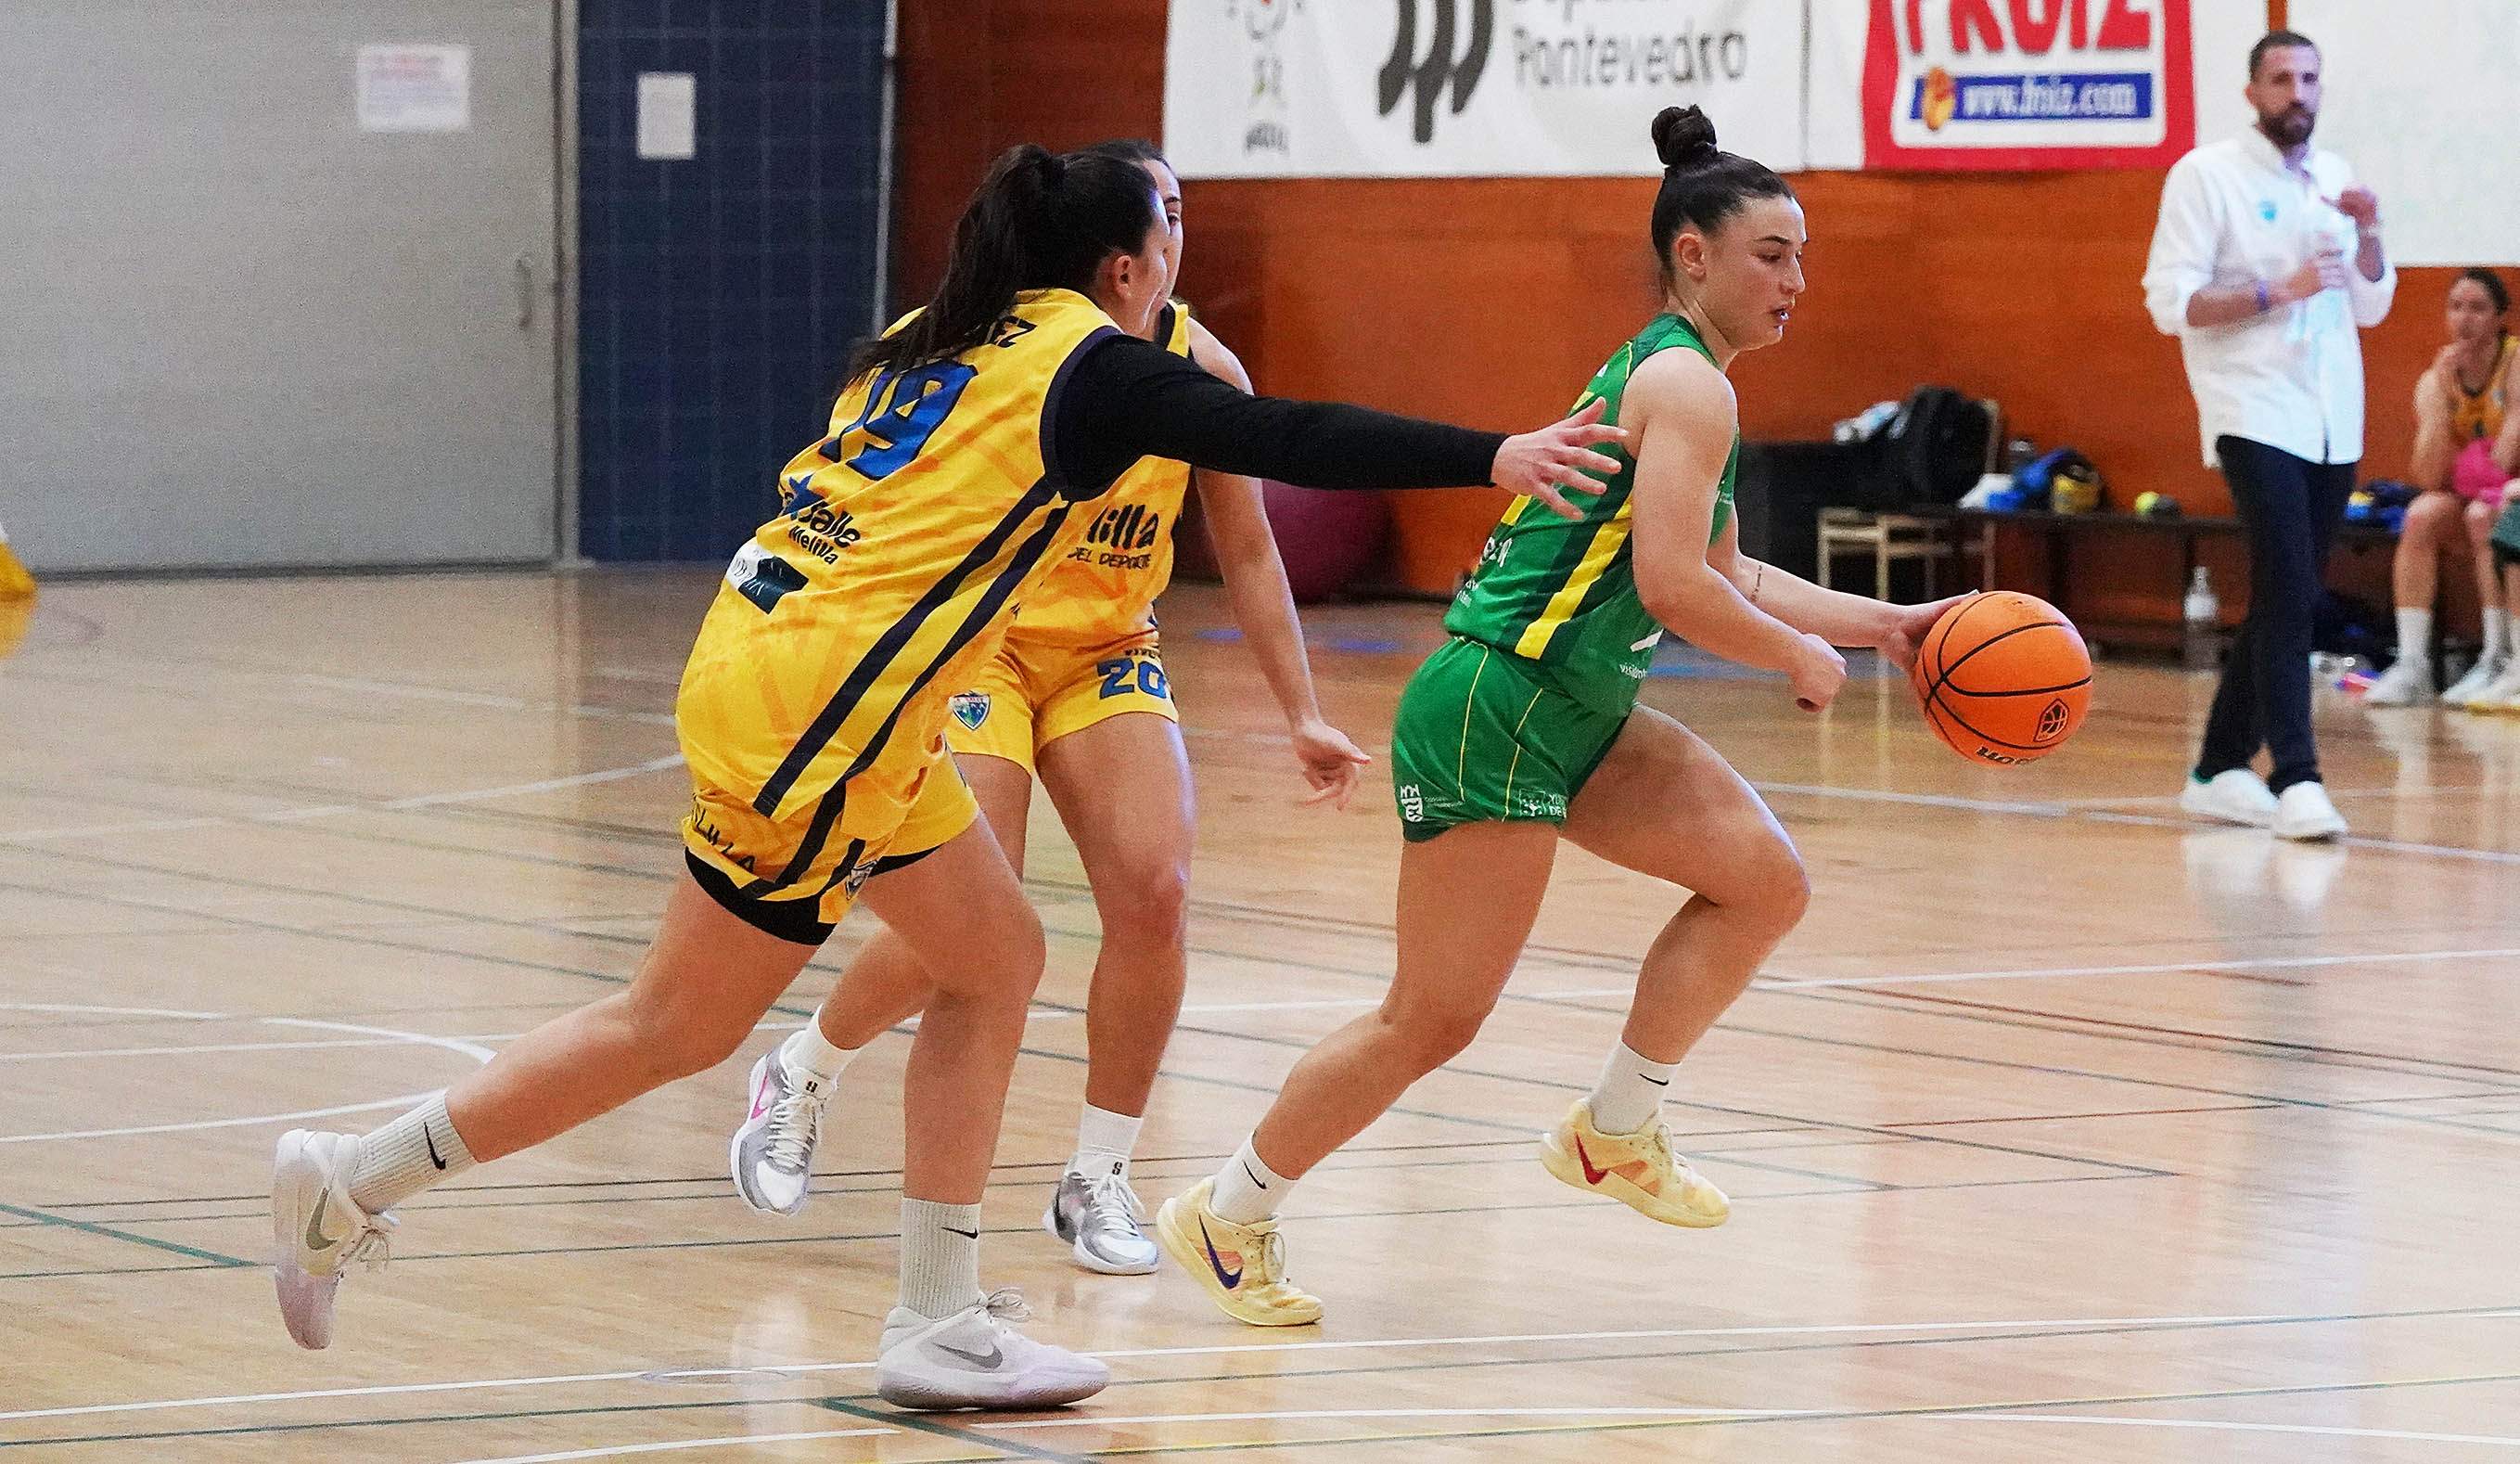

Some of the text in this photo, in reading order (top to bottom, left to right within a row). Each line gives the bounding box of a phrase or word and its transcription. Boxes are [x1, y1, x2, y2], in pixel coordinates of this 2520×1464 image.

[818, 359, 979, 482] 19
[1086, 503, 1159, 550] lilla
[1096, 658, 1167, 700] 20
